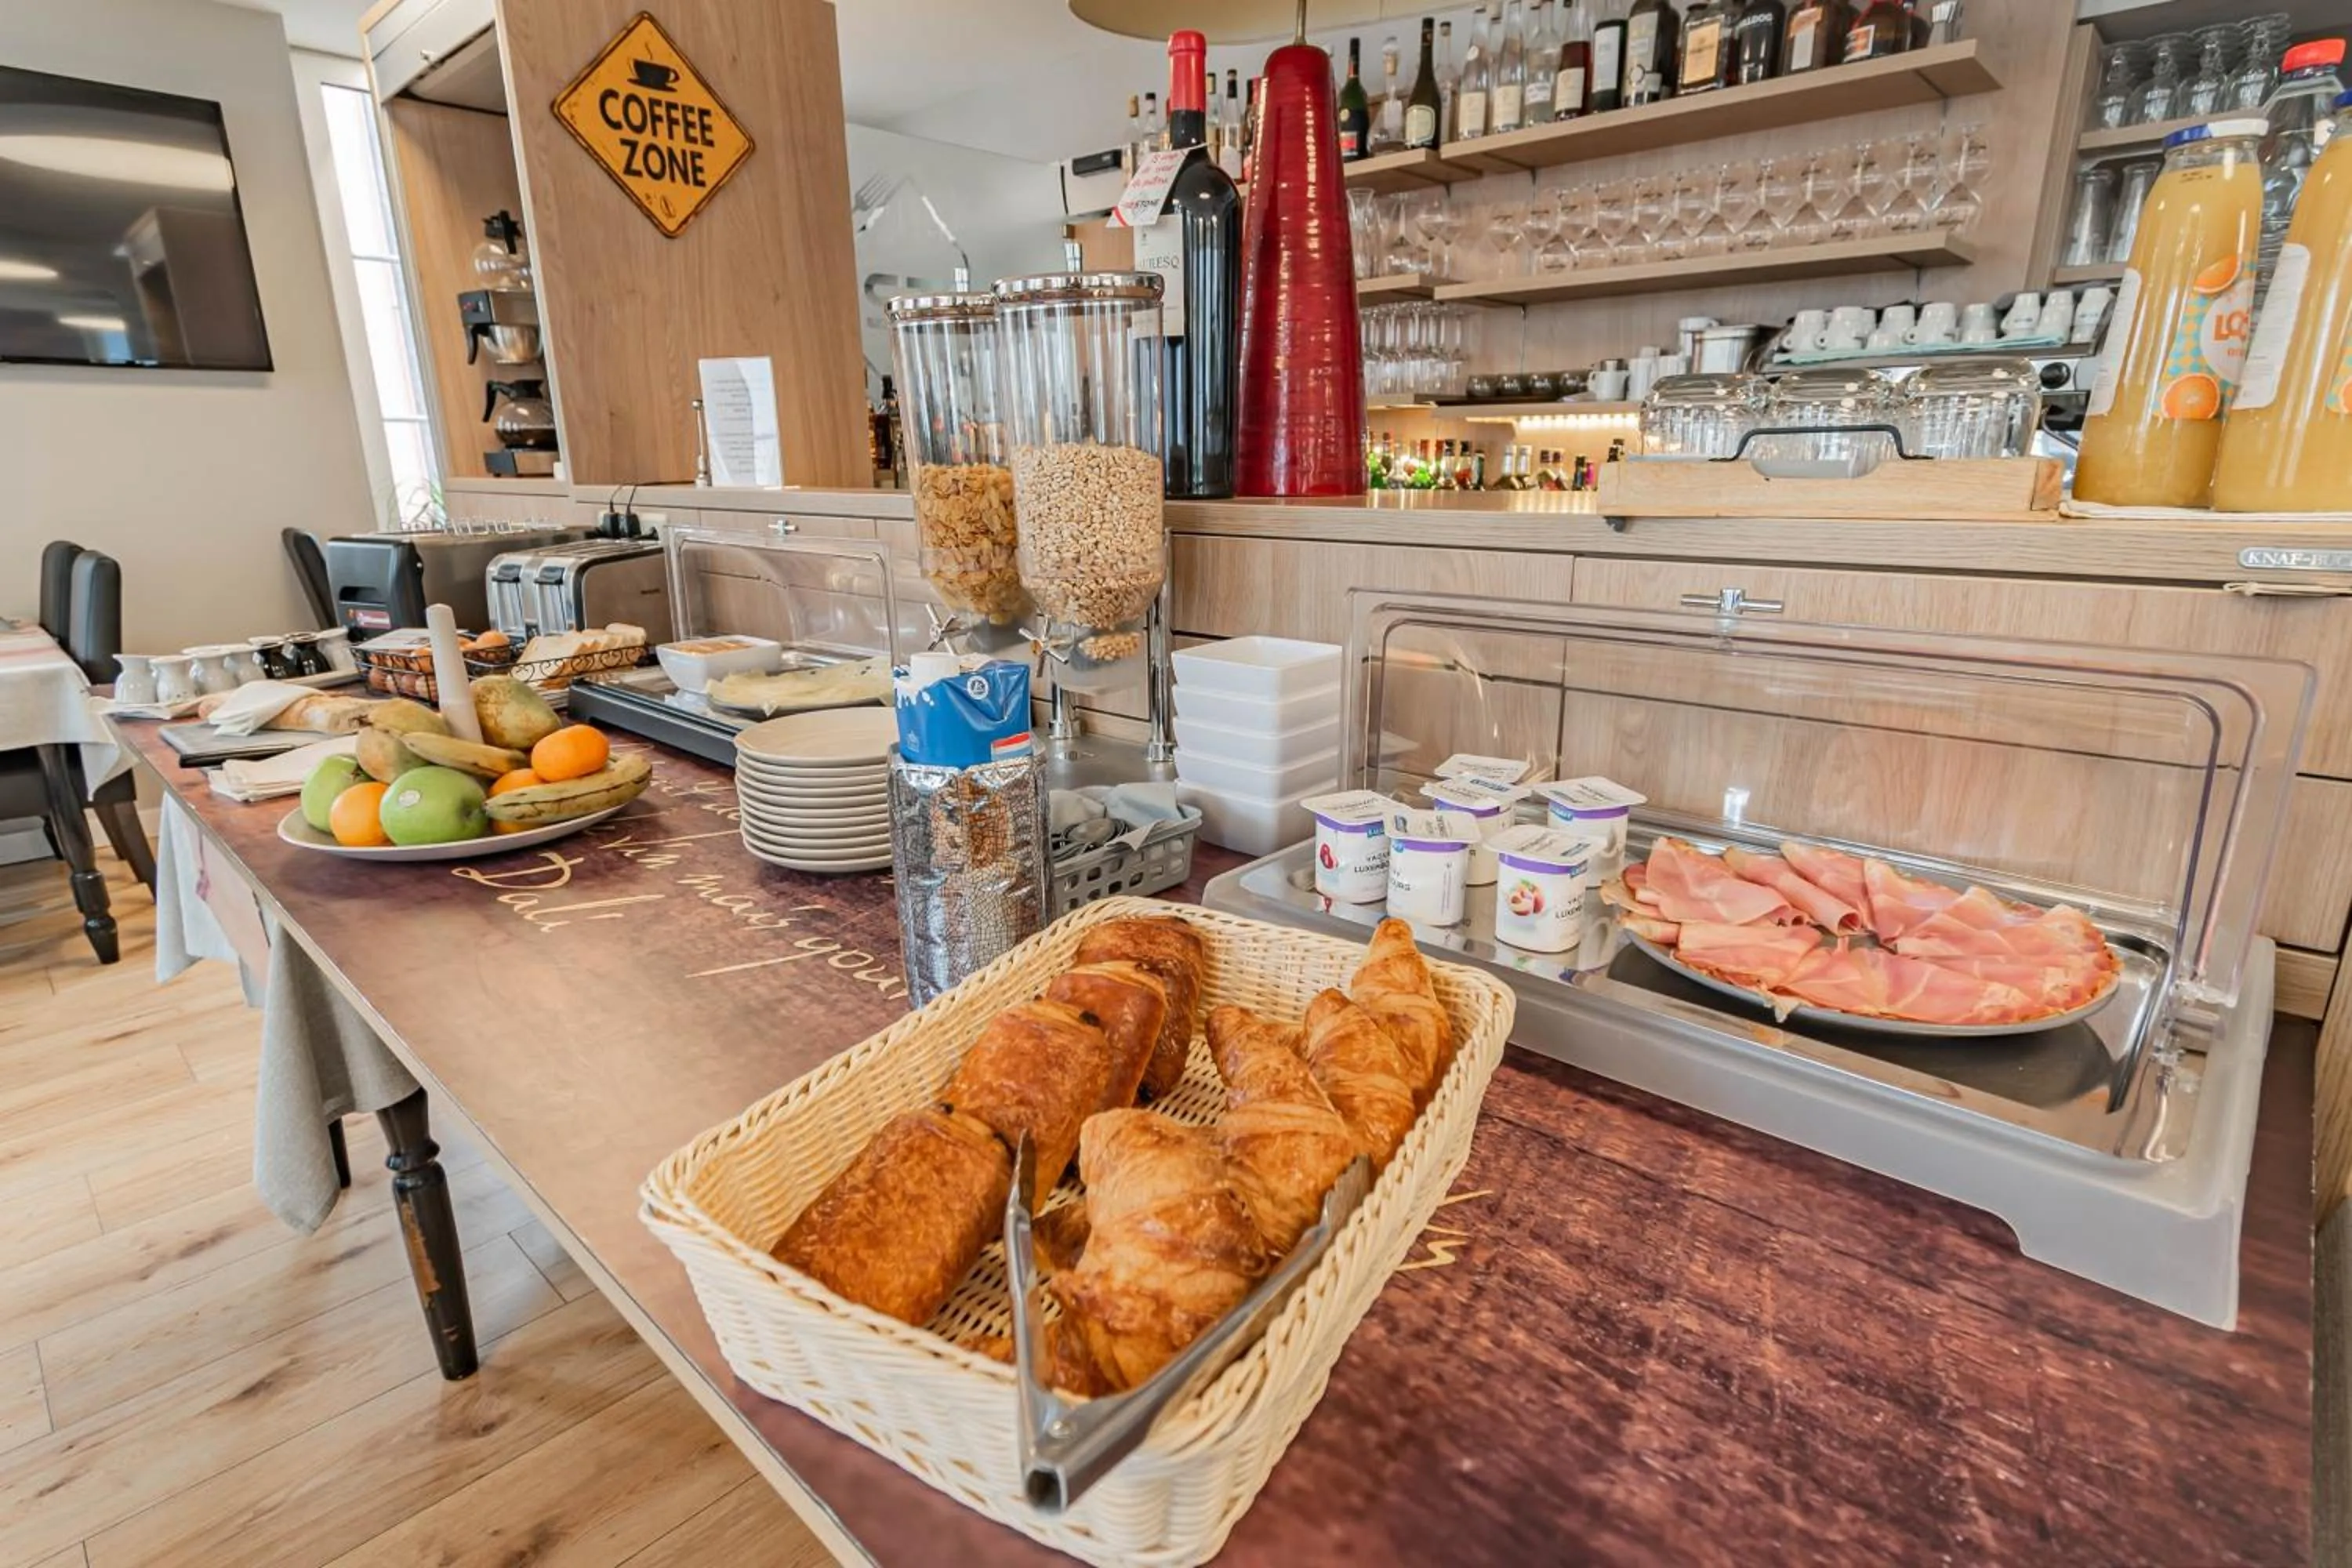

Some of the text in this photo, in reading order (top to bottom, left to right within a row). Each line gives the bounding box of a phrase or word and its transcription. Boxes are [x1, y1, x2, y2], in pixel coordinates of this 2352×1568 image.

[598, 89, 714, 147] COFFEE
[619, 138, 706, 187] ZONE
[2248, 550, 2352, 566] KNAF-BUC
